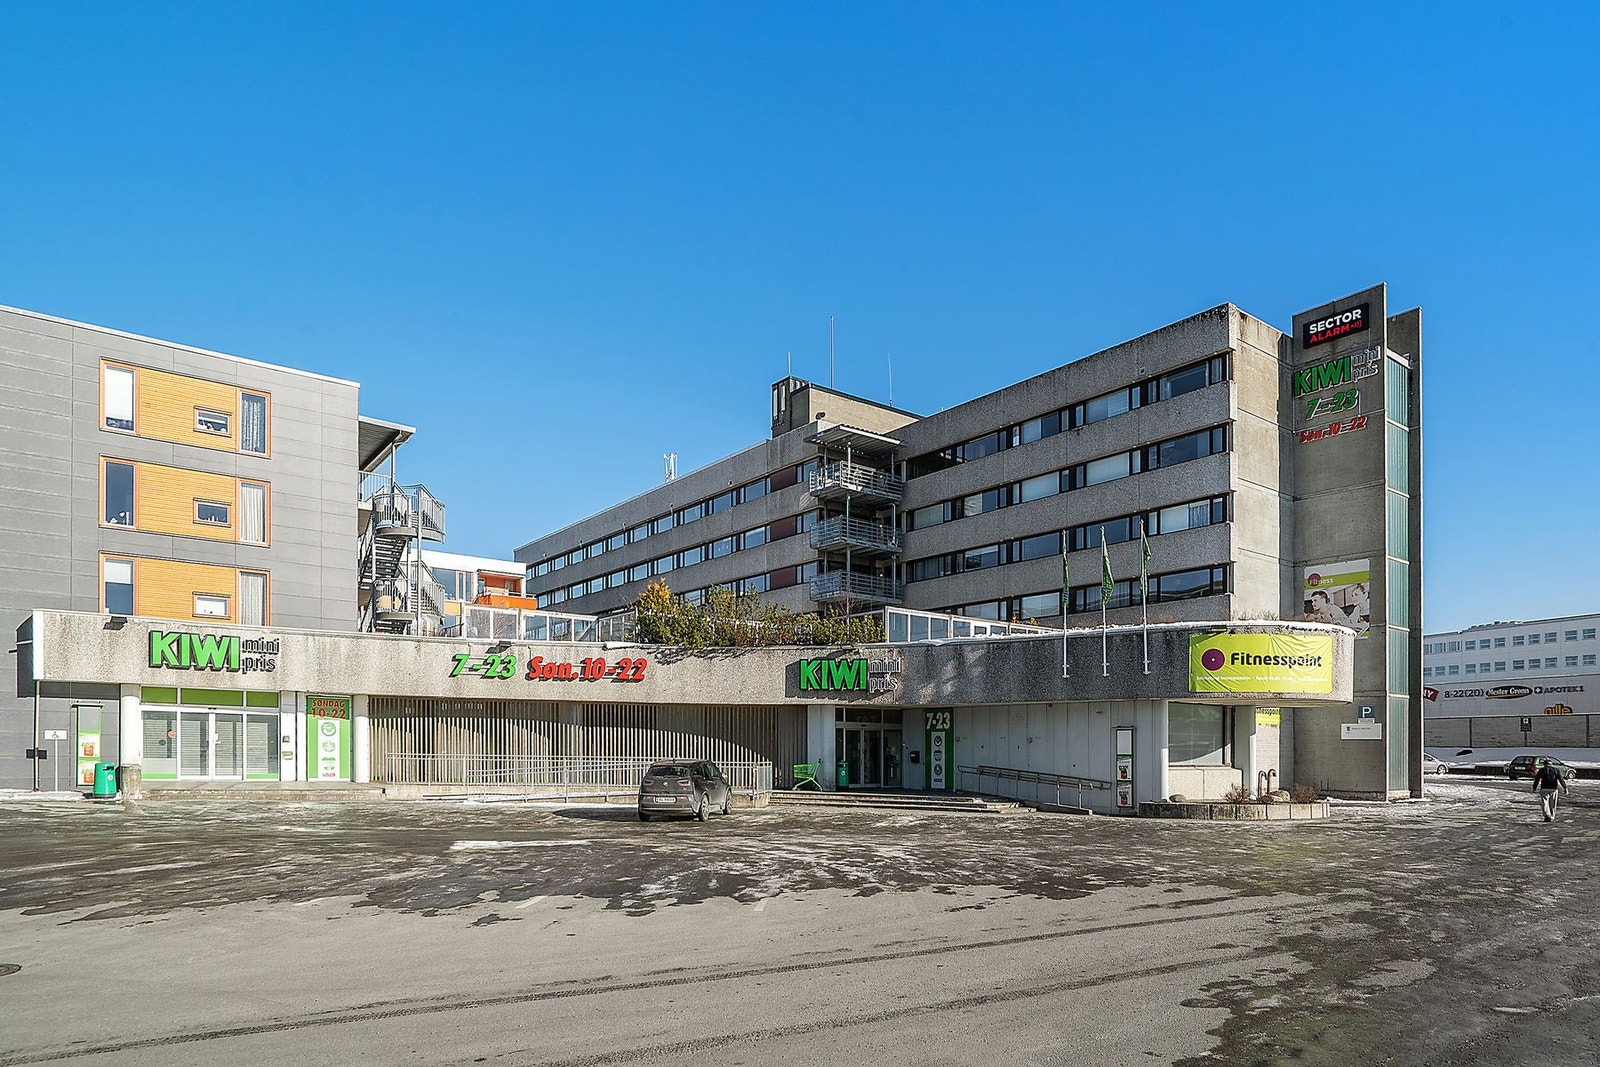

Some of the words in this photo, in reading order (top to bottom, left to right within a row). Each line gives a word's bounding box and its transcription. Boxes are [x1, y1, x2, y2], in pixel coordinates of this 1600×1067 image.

[1309, 309, 1362, 334] SECTOR
[1309, 323, 1350, 344] ALARM
[1293, 356, 1351, 398] KIWI
[1305, 388, 1360, 421] 7-23
[1328, 415, 1367, 437] 10-22
[149, 630, 240, 672] KIWI
[242, 637, 280, 654] mini
[242, 655, 276, 674] pris
[450, 653, 517, 679] 7-23
[527, 655, 578, 681] Søn.
[583, 657, 648, 682] 10-22
[870, 657, 901, 673] mini
[1230, 652, 1322, 669] Fitnesspoint
[800, 658, 868, 691] KIWI
[870, 674, 897, 693] pris
[1444, 688, 1484, 698] 8-22(20)
[1544, 686, 1578, 694] APOTEK
[311, 708, 346, 719] 10-22
[312, 700, 345, 708] SØNDAG
[1362, 706, 1372, 718] P
[926, 711, 951, 730] 7-23
